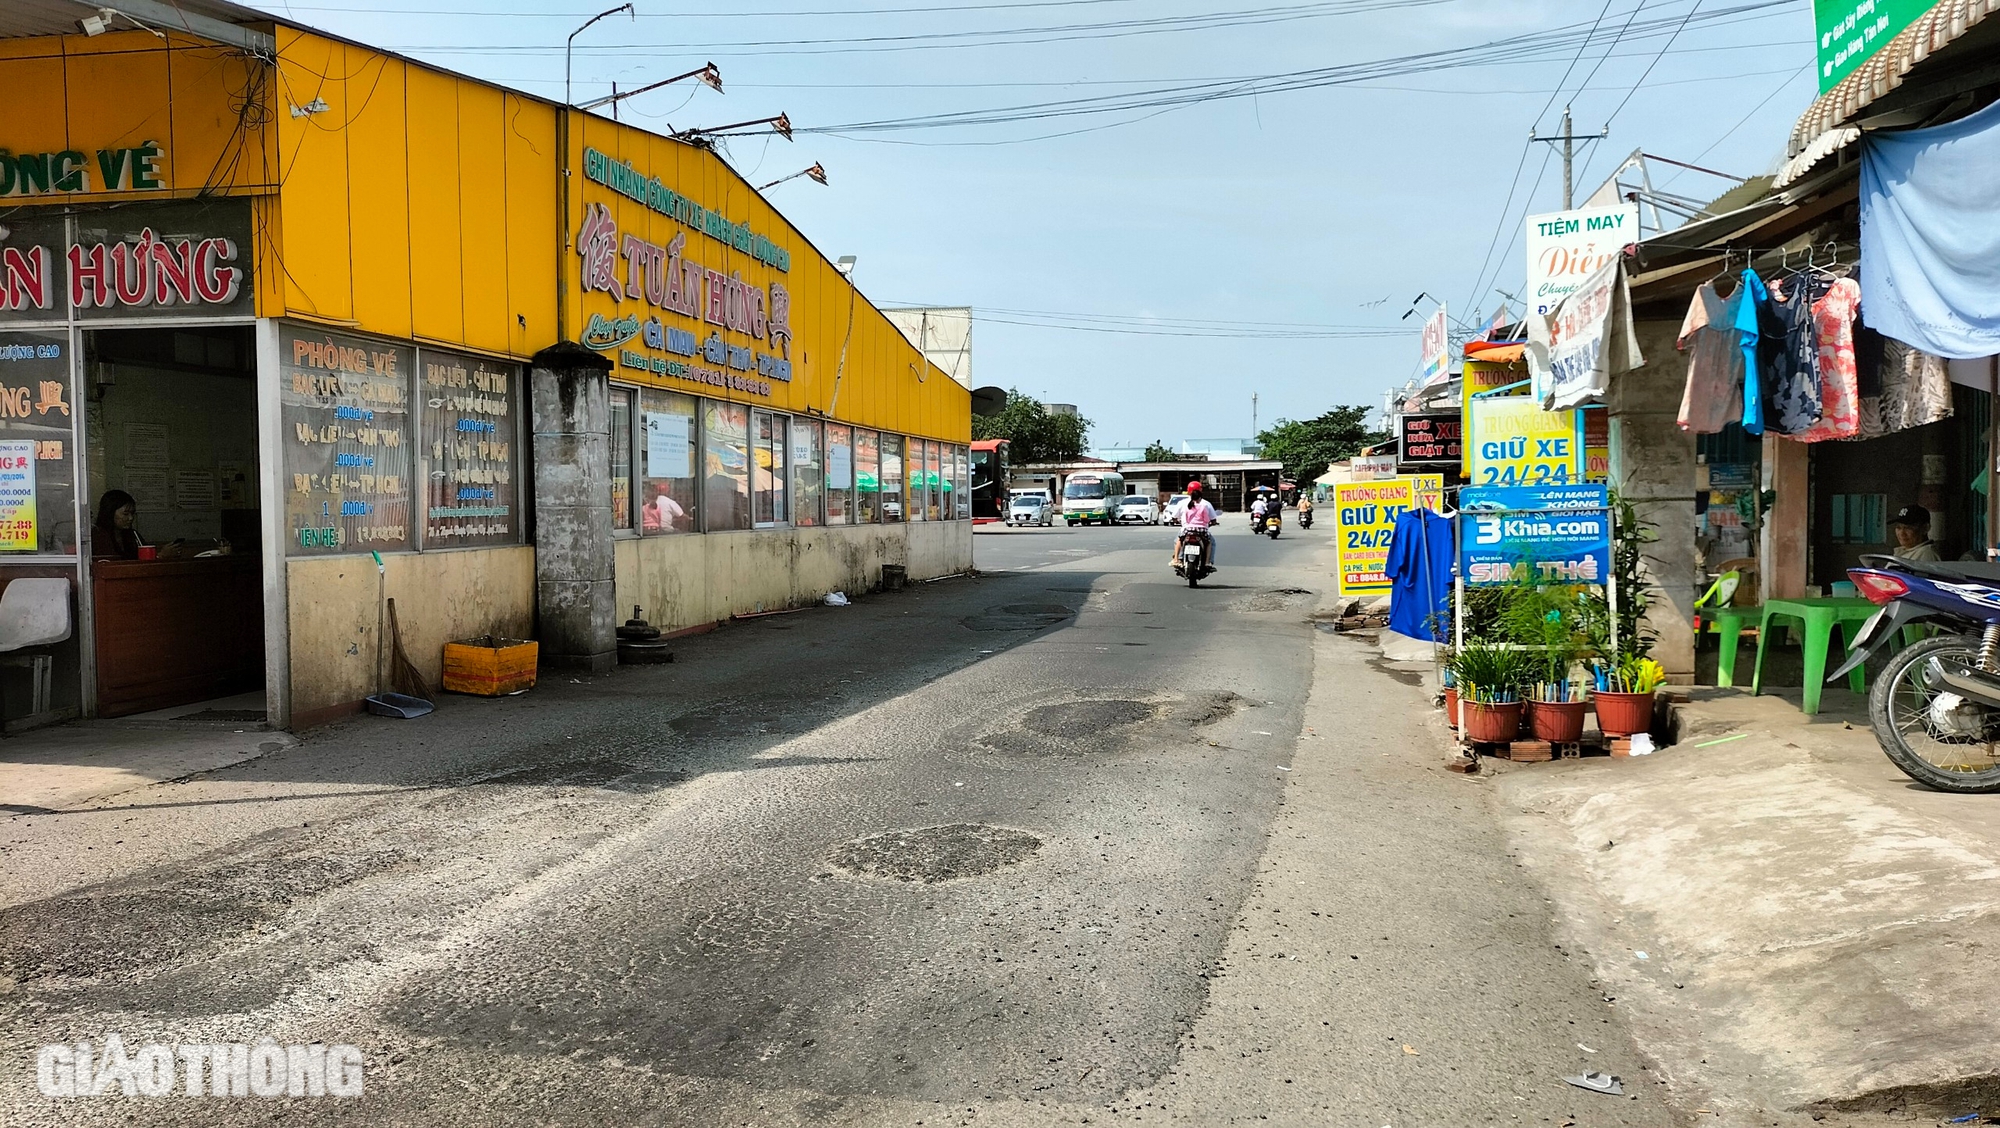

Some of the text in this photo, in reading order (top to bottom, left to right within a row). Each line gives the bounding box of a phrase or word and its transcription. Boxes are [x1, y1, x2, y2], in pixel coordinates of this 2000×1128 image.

[97, 140, 165, 190] VÉ
[584, 147, 608, 185] CHI
[609, 159, 648, 205] NHÁNH
[648, 176, 675, 217] CÔNG
[675, 193, 690, 224] TY
[689, 200, 703, 231] XE
[703, 208, 733, 245] KHÁCH
[1538, 214, 1625, 238] TIỆM MAY
[67, 227, 244, 309] HƯNG
[621, 231, 766, 340] TUẤN HƯNG
[37, 345, 60, 358] CAO
[644, 315, 664, 349] CÀ
[665, 326, 695, 357] MAU
[703, 331, 726, 365] CẦN
[728, 344, 751, 372] THƠ
[293, 335, 397, 379] PHÒNG VÉ
[621, 350, 649, 370] Liên
[650, 356, 666, 377] hệ
[1473, 367, 1514, 386] TRƯỜNG
[1435, 422, 1461, 440] XE
[1482, 436, 1527, 460] GIỮ
[1536, 439, 1569, 458] XE
[1341, 486, 1408, 502] TRƯỜNG GIANG
[1540, 491, 1564, 499] LÊN
[1547, 500, 1600, 509] KHÔNG
[1342, 504, 1377, 525] GIỮ
[1347, 530, 1393, 549] 24/2
[1476, 514, 1502, 544] 3
[1469, 554, 1598, 583] SIM THẺ
